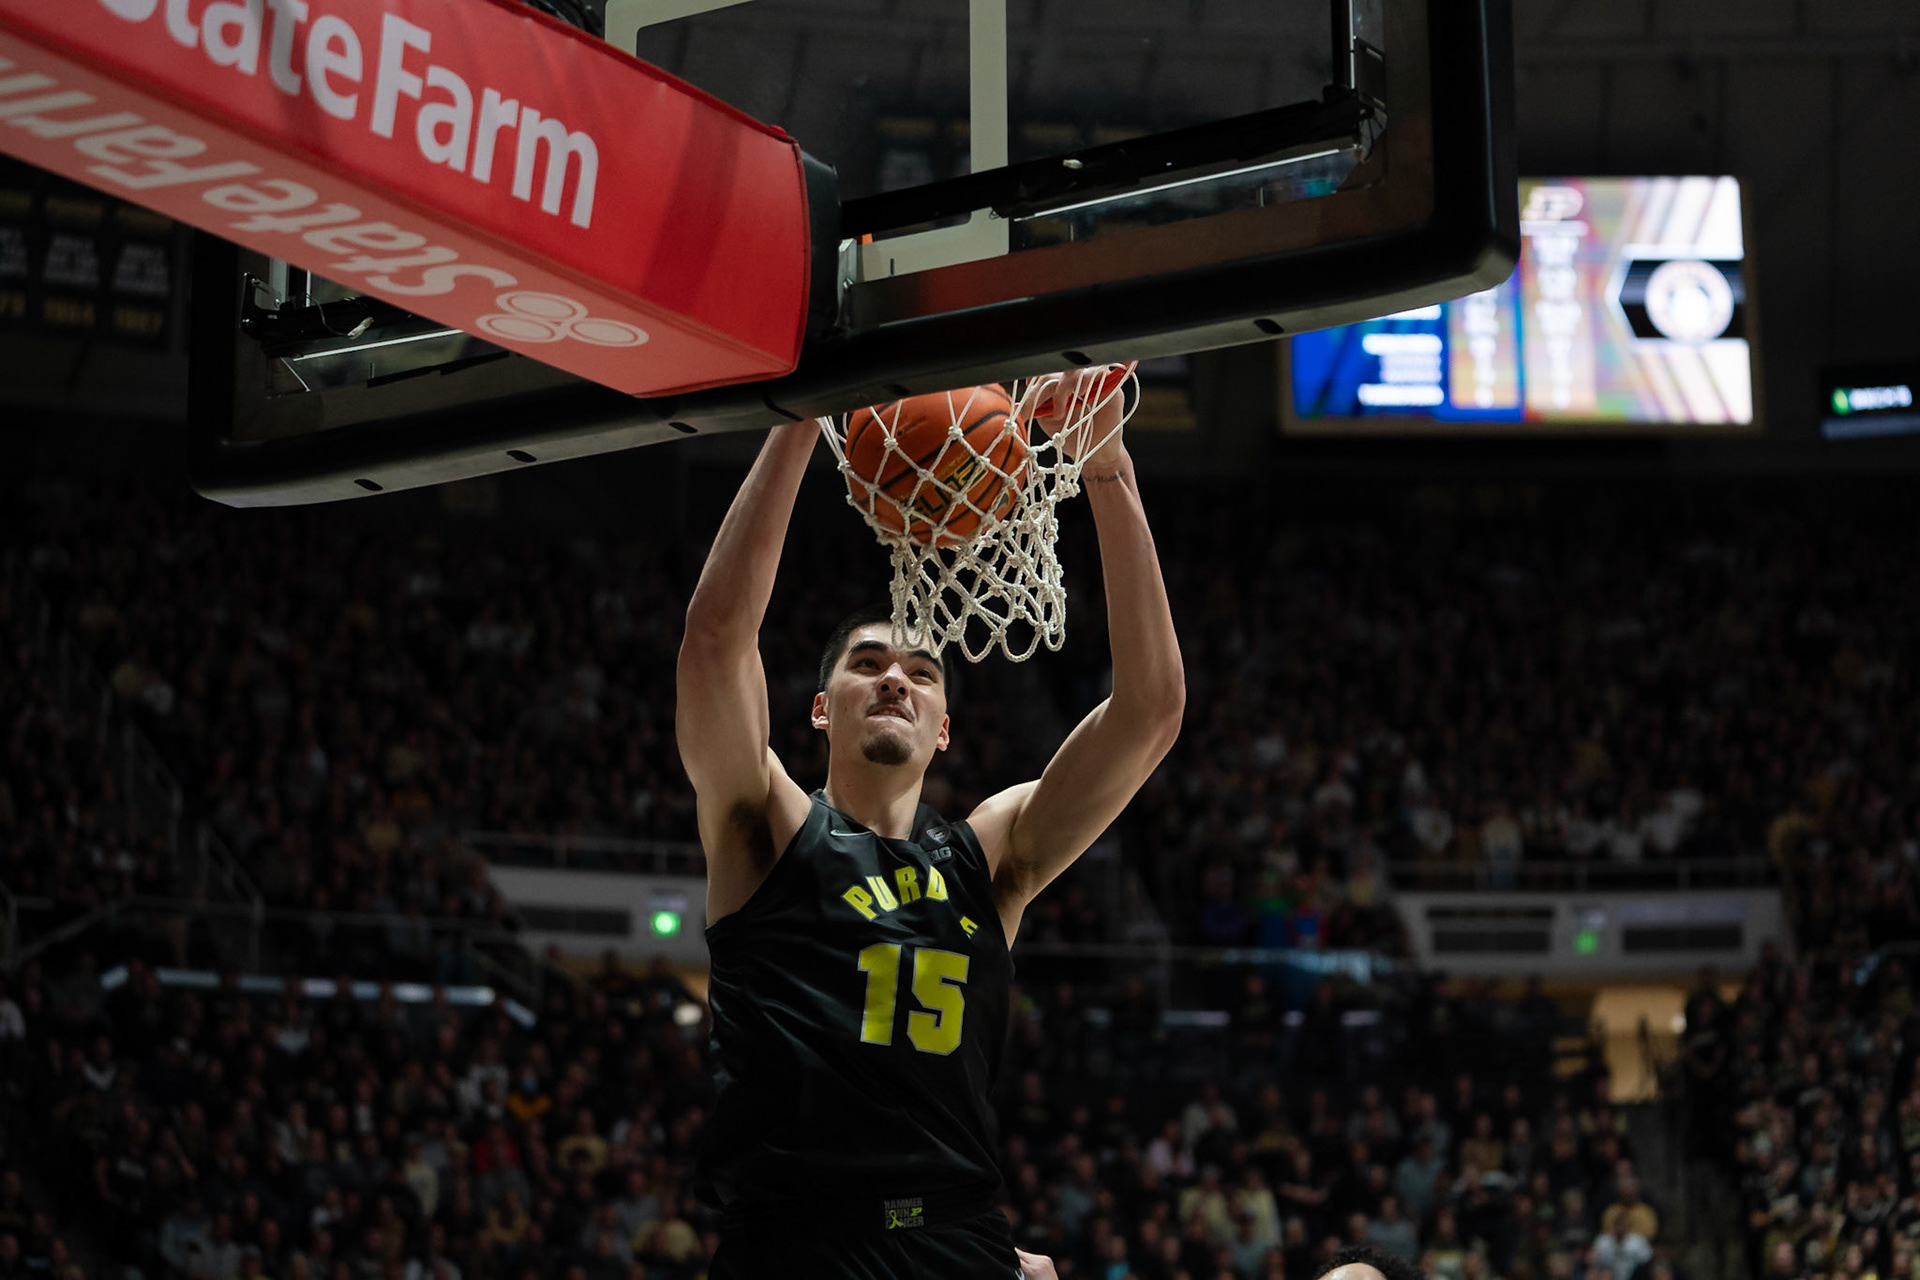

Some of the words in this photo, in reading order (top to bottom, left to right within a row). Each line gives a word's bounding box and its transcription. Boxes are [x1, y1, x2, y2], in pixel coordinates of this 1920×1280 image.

[97, 0, 599, 229] ateFarm
[841, 864, 981, 941] PURDE
[857, 942, 970, 1056] 15
[885, 1215, 925, 1229] CNCER
